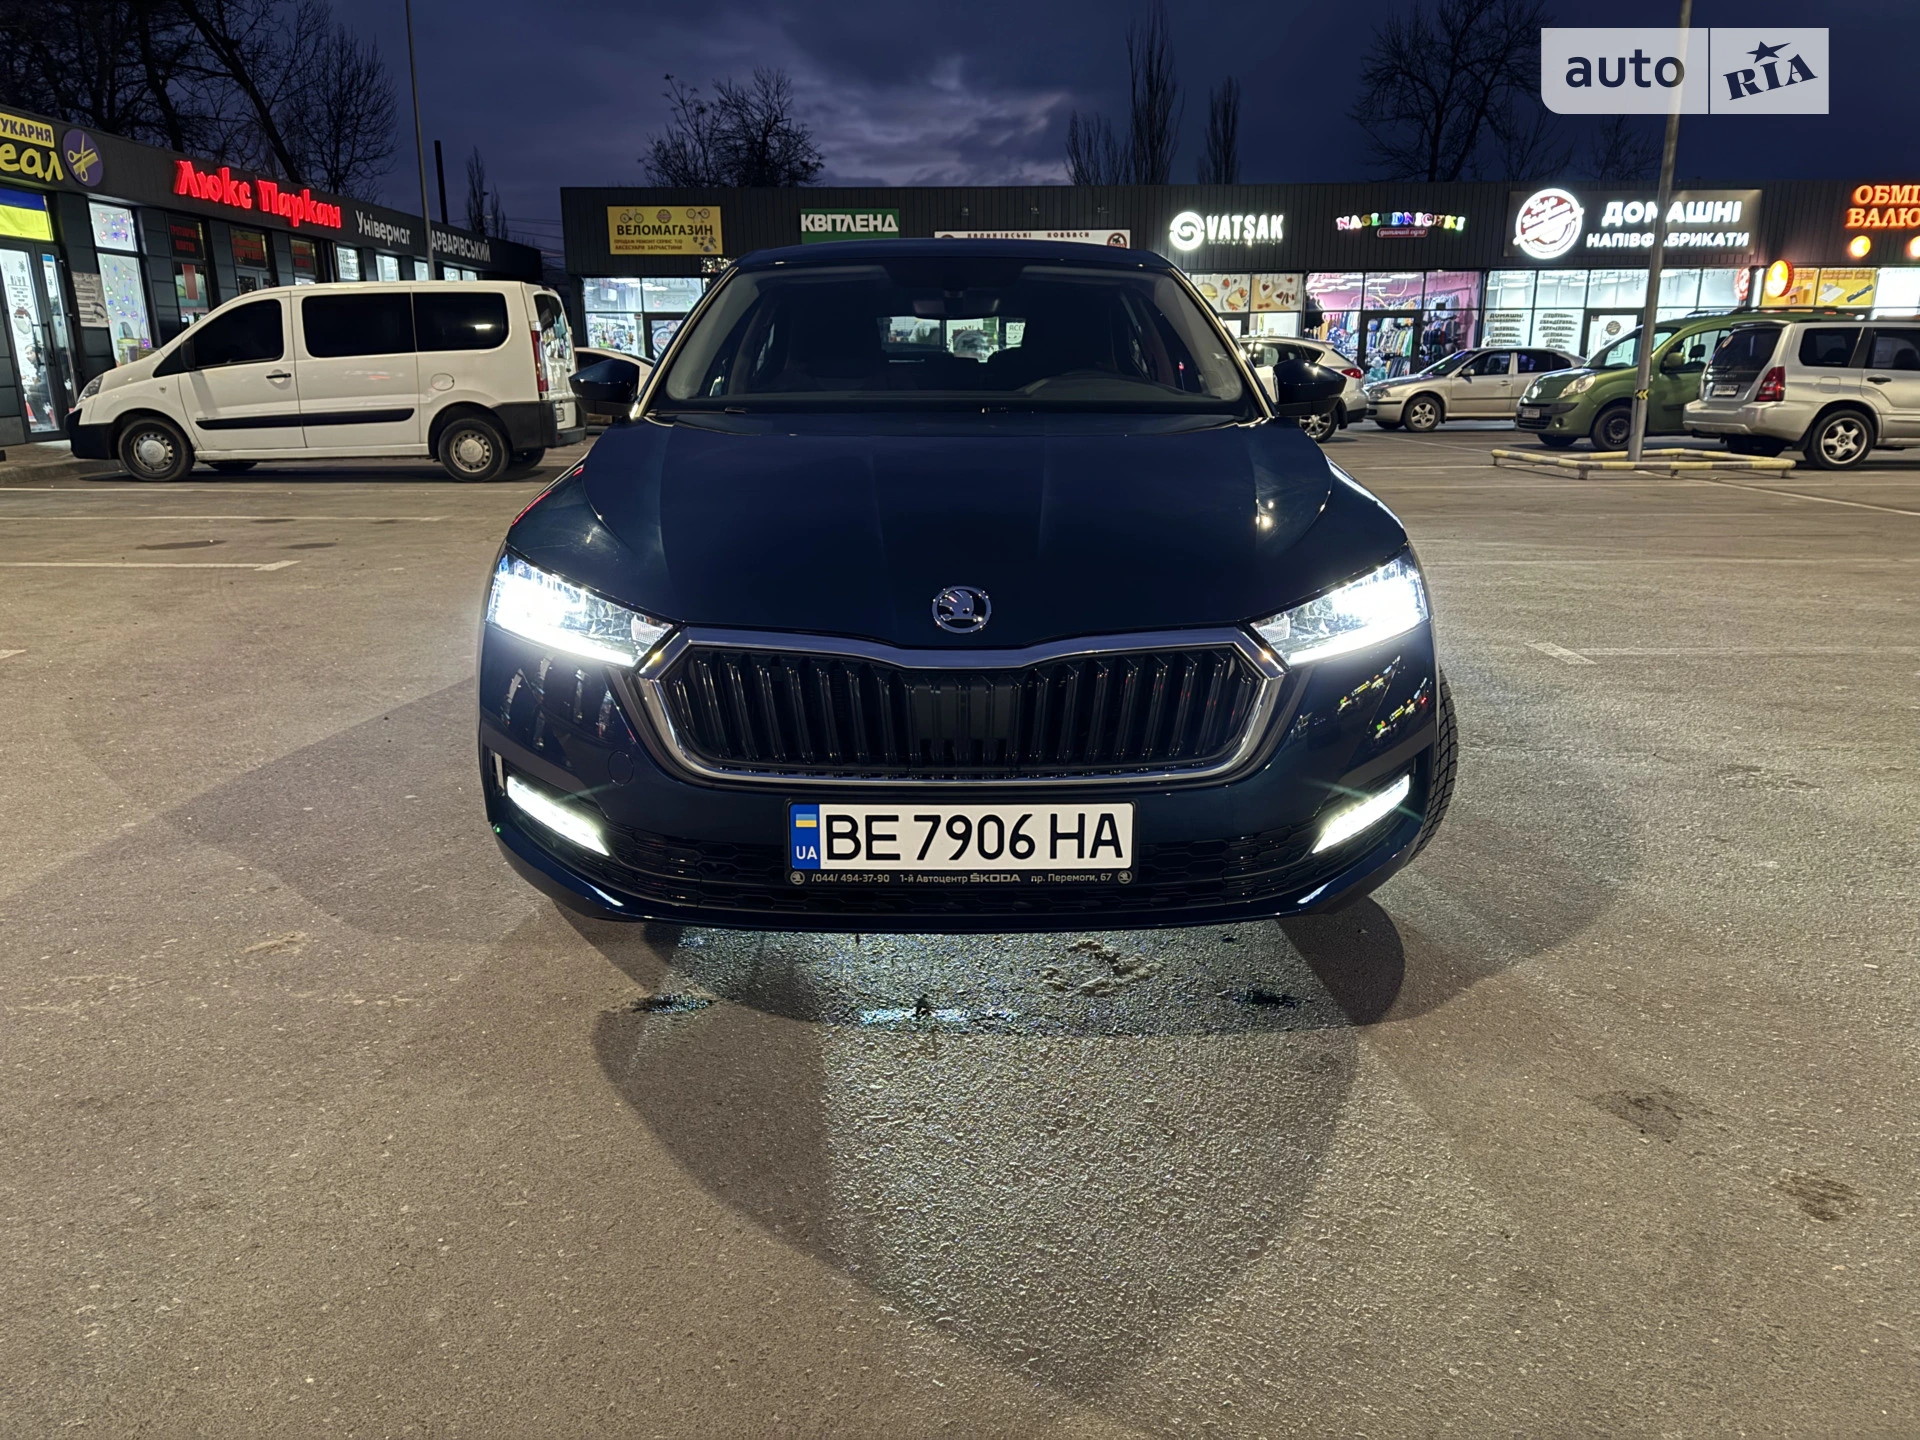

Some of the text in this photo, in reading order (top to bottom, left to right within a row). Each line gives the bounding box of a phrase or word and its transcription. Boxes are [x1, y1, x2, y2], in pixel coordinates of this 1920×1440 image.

[0, 118, 52, 143] УКАРНЯ
[174, 160, 342, 229] Люкс Паркан
[800, 214, 899, 232] КВІТЛЕНД
[1336, 212, 1466, 231] NASLEDNICHKI
[1601, 201, 1743, 227] ДОМАШНІ
[1846, 208, 1920, 228] ВАЛЮ
[355, 210, 491, 263] Універмаг АРВАРІВСЬКИЙ
[616, 225, 713, 235] ВЕЛОМАГАЗИН
[1206, 214, 1284, 240] VATSAK
[1586, 232, 1749, 248] НАПІВФБРИКАТИ
[825, 813, 1124, 861] BE 7906 HA
[795, 846, 818, 860] UA
[840, 873, 890, 882] 494-37-90
[900, 873, 914, 882] 1-й
[916, 874, 968, 883] Автоцентр
[970, 872, 1021, 882] ŠKODA
[1031, 876, 1045, 884] пр.
[1048, 873, 1098, 884] Перемоги,
[1100, 873, 1112, 882] 67
